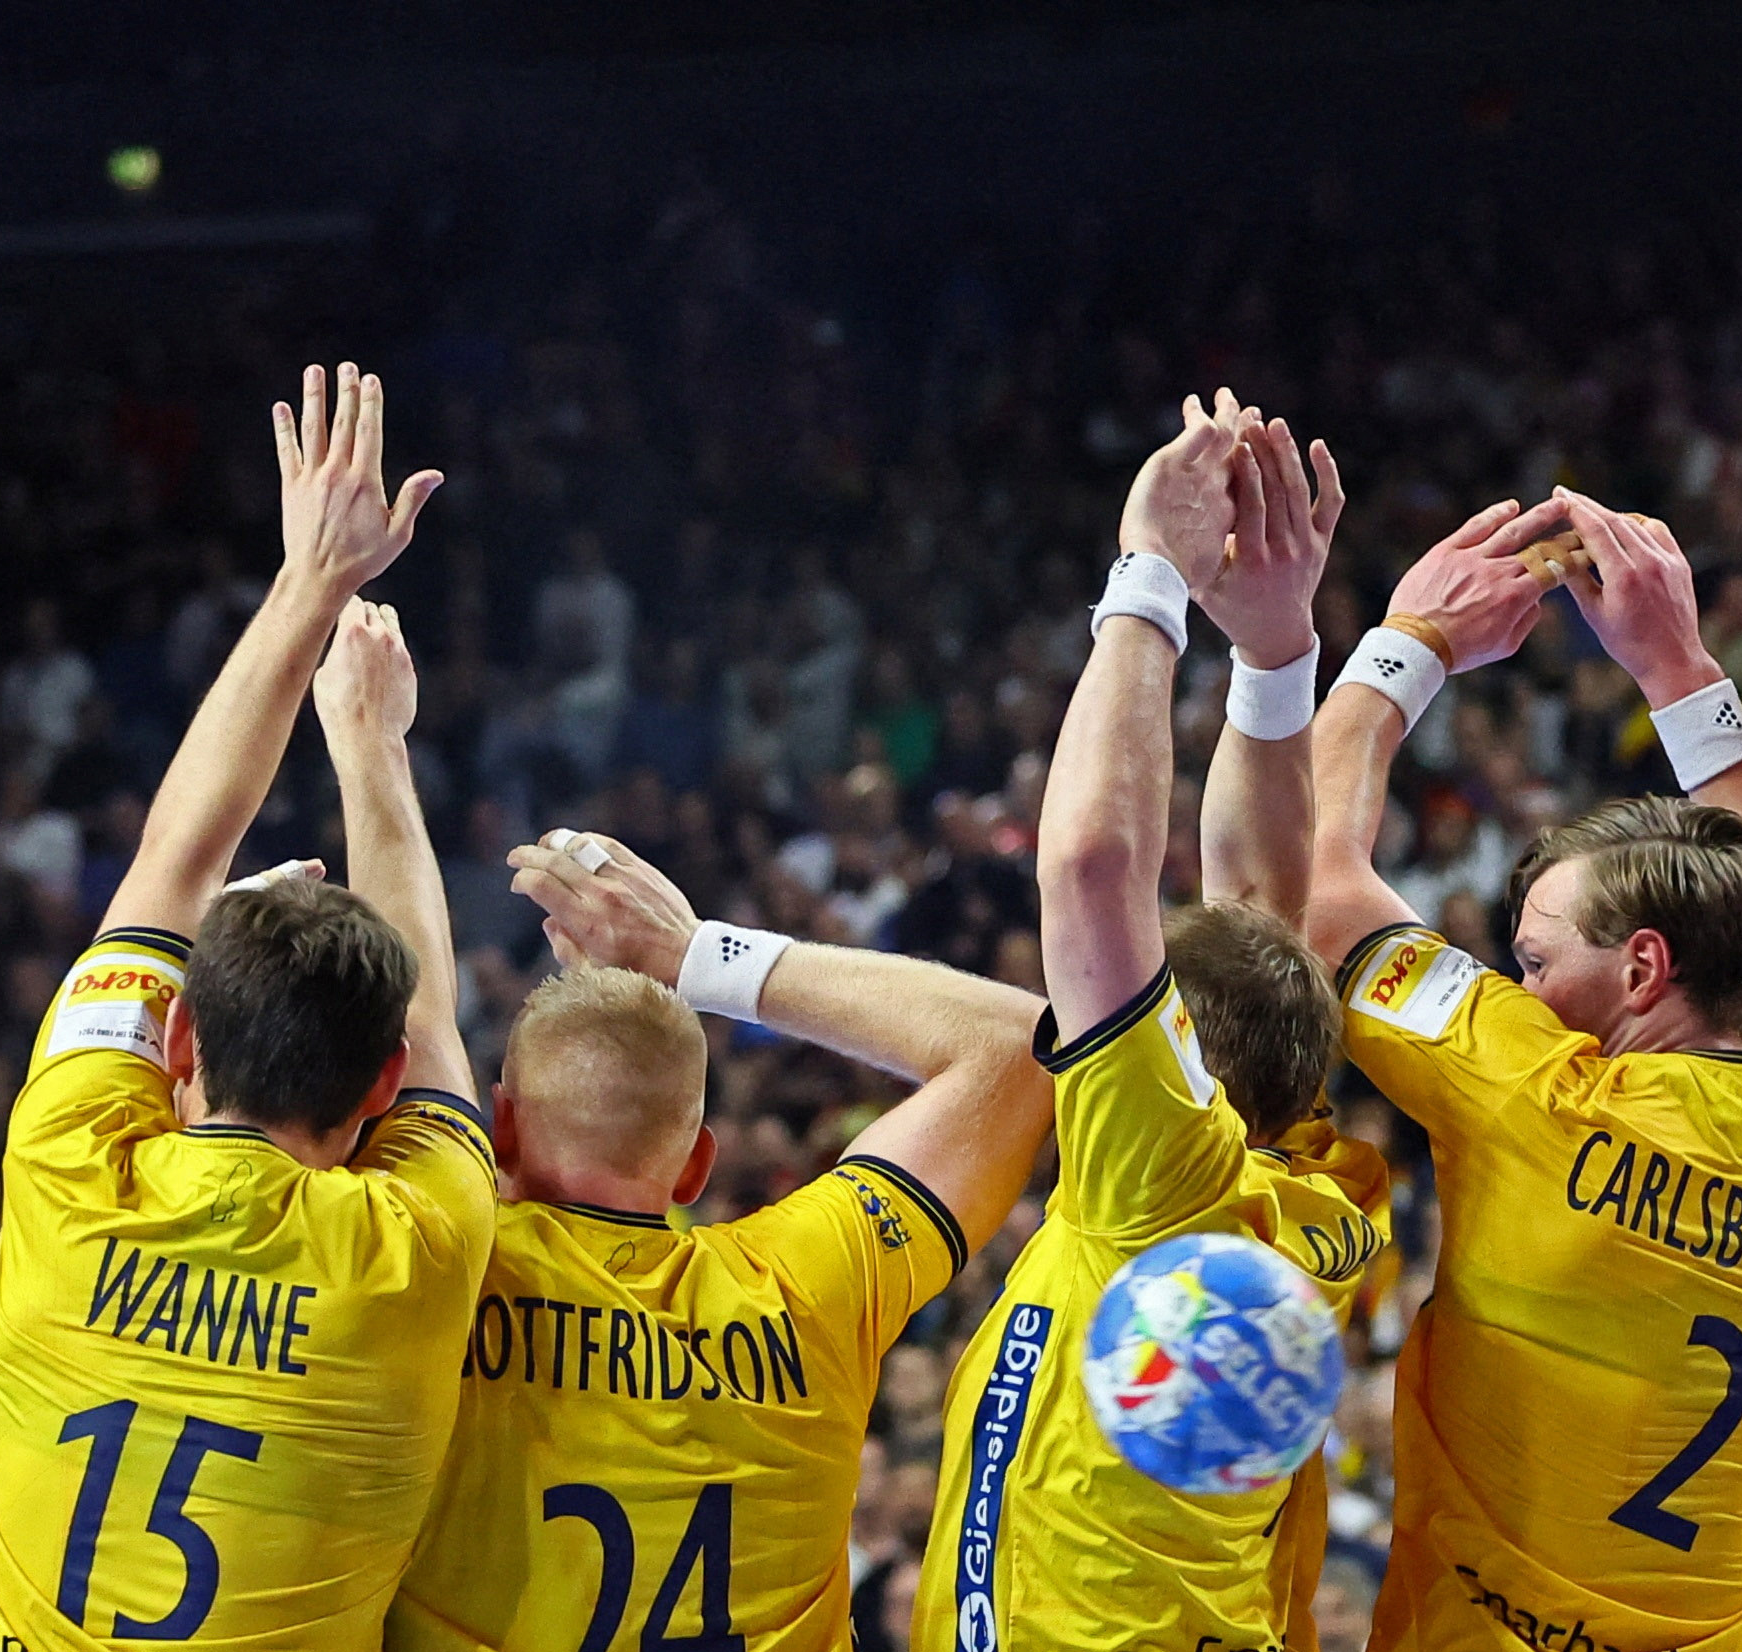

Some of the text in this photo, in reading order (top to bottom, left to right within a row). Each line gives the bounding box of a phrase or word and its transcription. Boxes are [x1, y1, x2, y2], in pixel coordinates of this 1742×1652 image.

[85, 1237, 317, 1376] WANNE
[55, 1398, 265, 1642] 15
[964, 1306, 1042, 1584] Gjensidige
